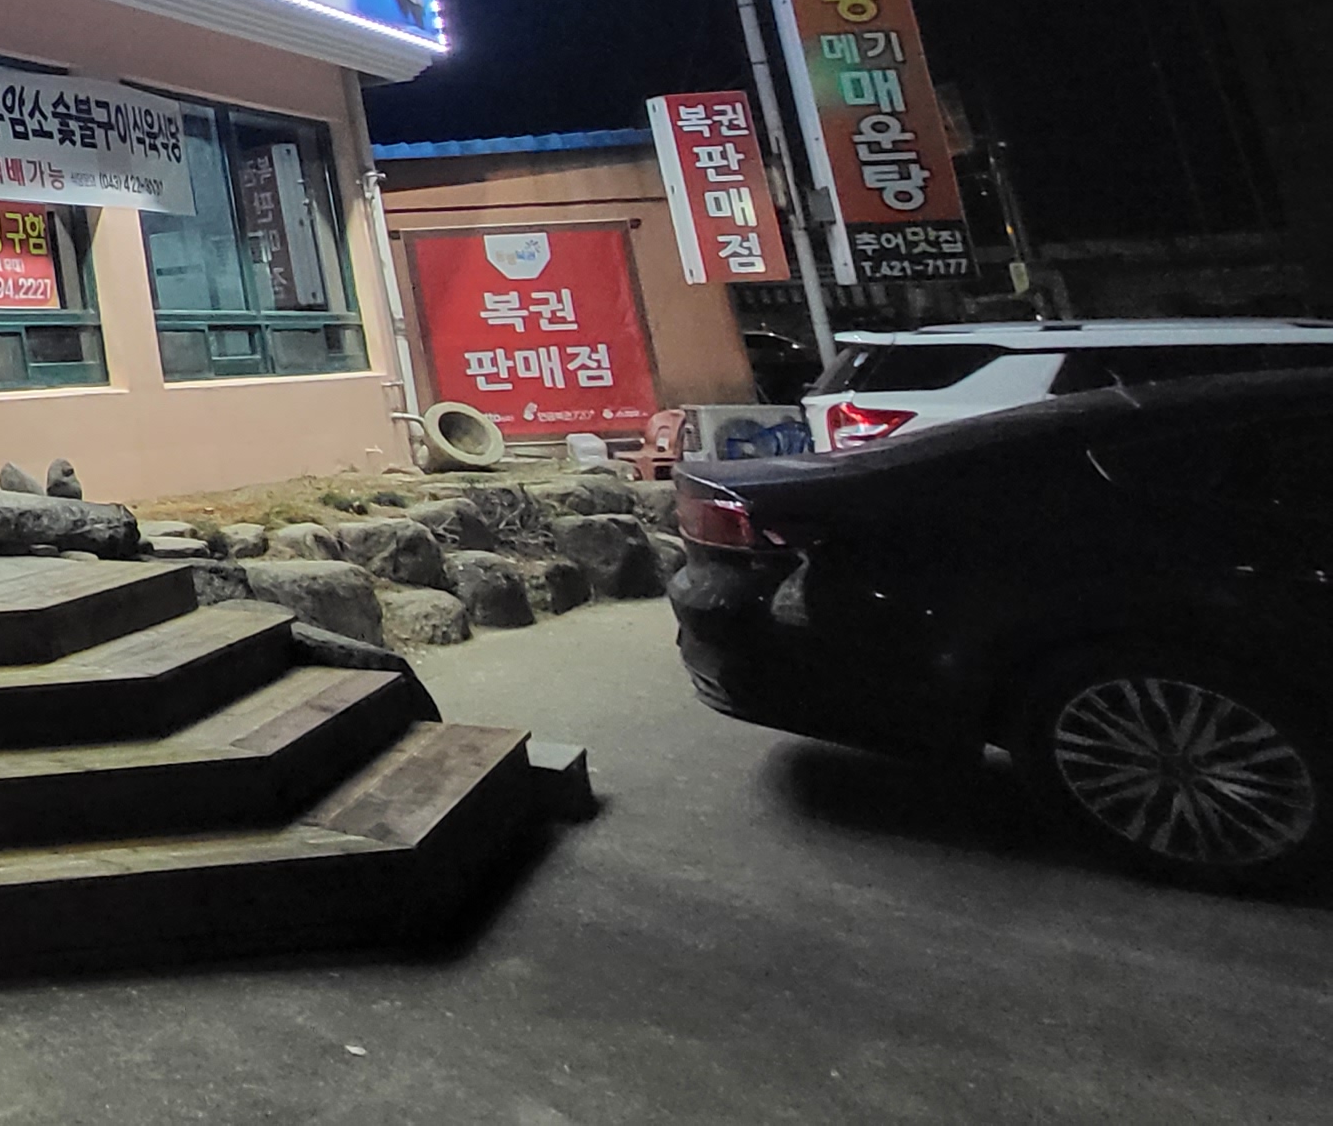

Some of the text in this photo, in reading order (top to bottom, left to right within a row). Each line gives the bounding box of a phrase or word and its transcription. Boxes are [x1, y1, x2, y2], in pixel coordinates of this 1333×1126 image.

[820, 31, 906, 64] 메기
[677, 102, 750, 138] 복권
[839, 69, 931, 211] 매운탕
[692, 143, 766, 273] 판매점
[5, 212, 48, 255] 구함
[854, 226, 964, 256] 추어맛집
[479, 288, 578, 333] 복권
[464, 343, 614, 392] 판매점
